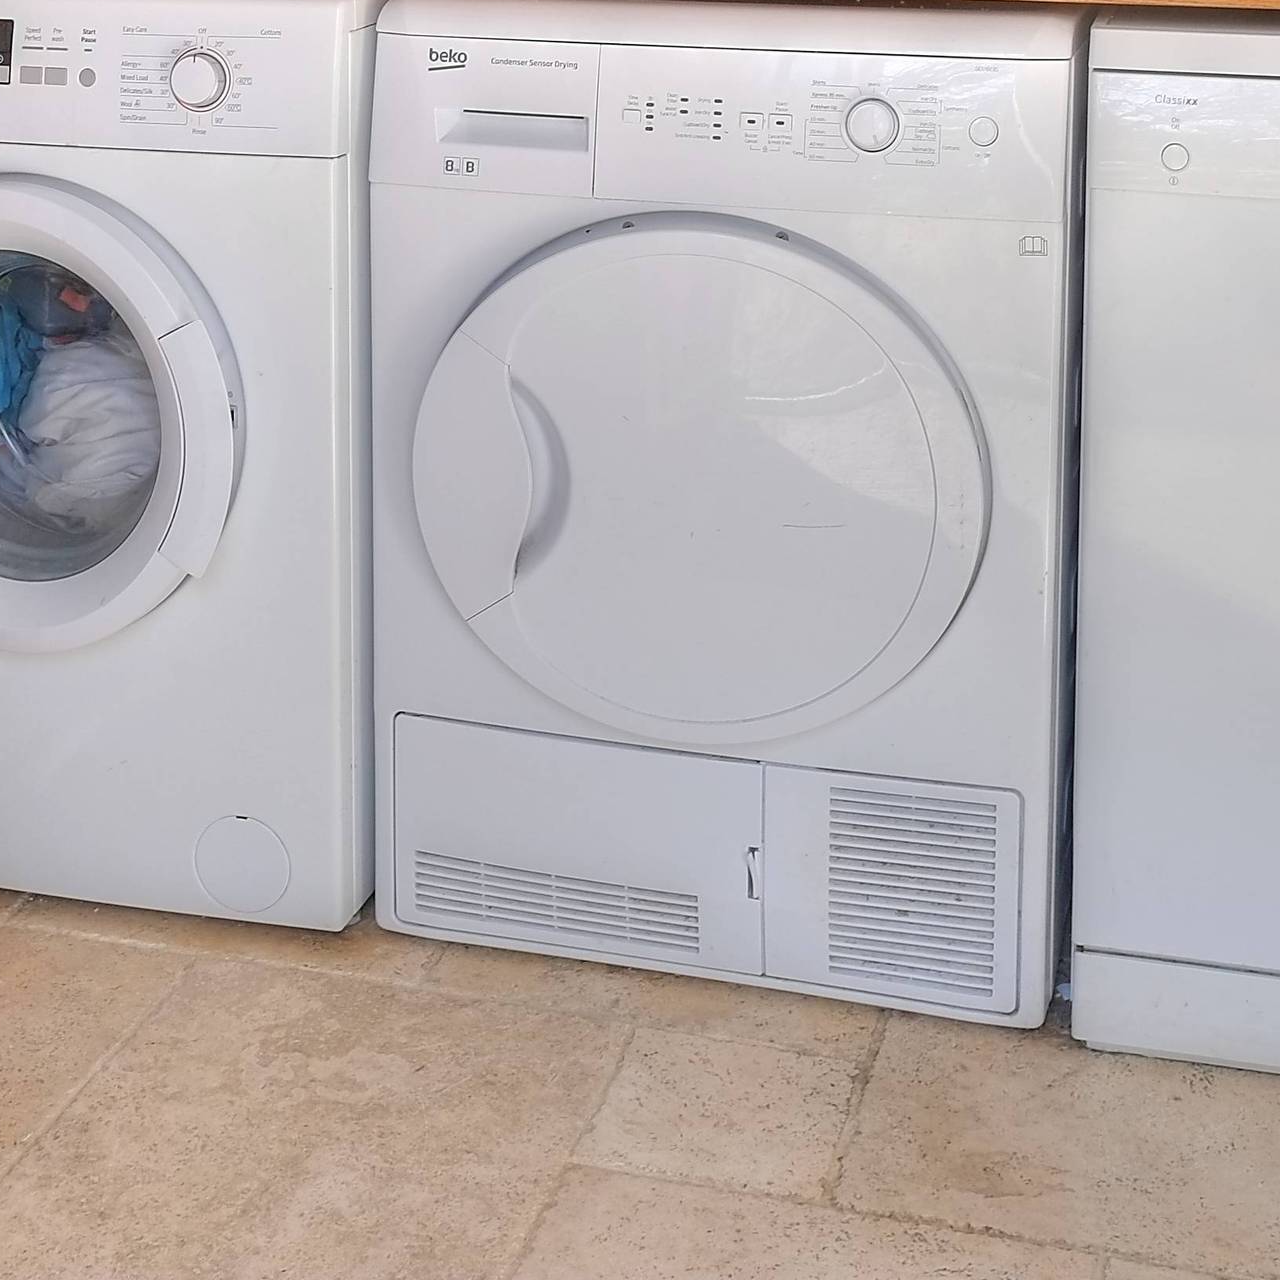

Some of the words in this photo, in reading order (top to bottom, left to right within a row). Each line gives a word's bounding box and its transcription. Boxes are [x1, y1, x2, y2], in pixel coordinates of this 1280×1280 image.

[82, 28, 97, 36] Start
[428, 47, 468, 64] beko
[490, 57, 528, 67] Condenser
[529, 59, 553, 68] Sensor
[554, 60, 579, 71] Drying
[1154, 93, 1199, 106] Classixx
[445, 159, 455, 172] 8
[465, 160, 475, 173] B
